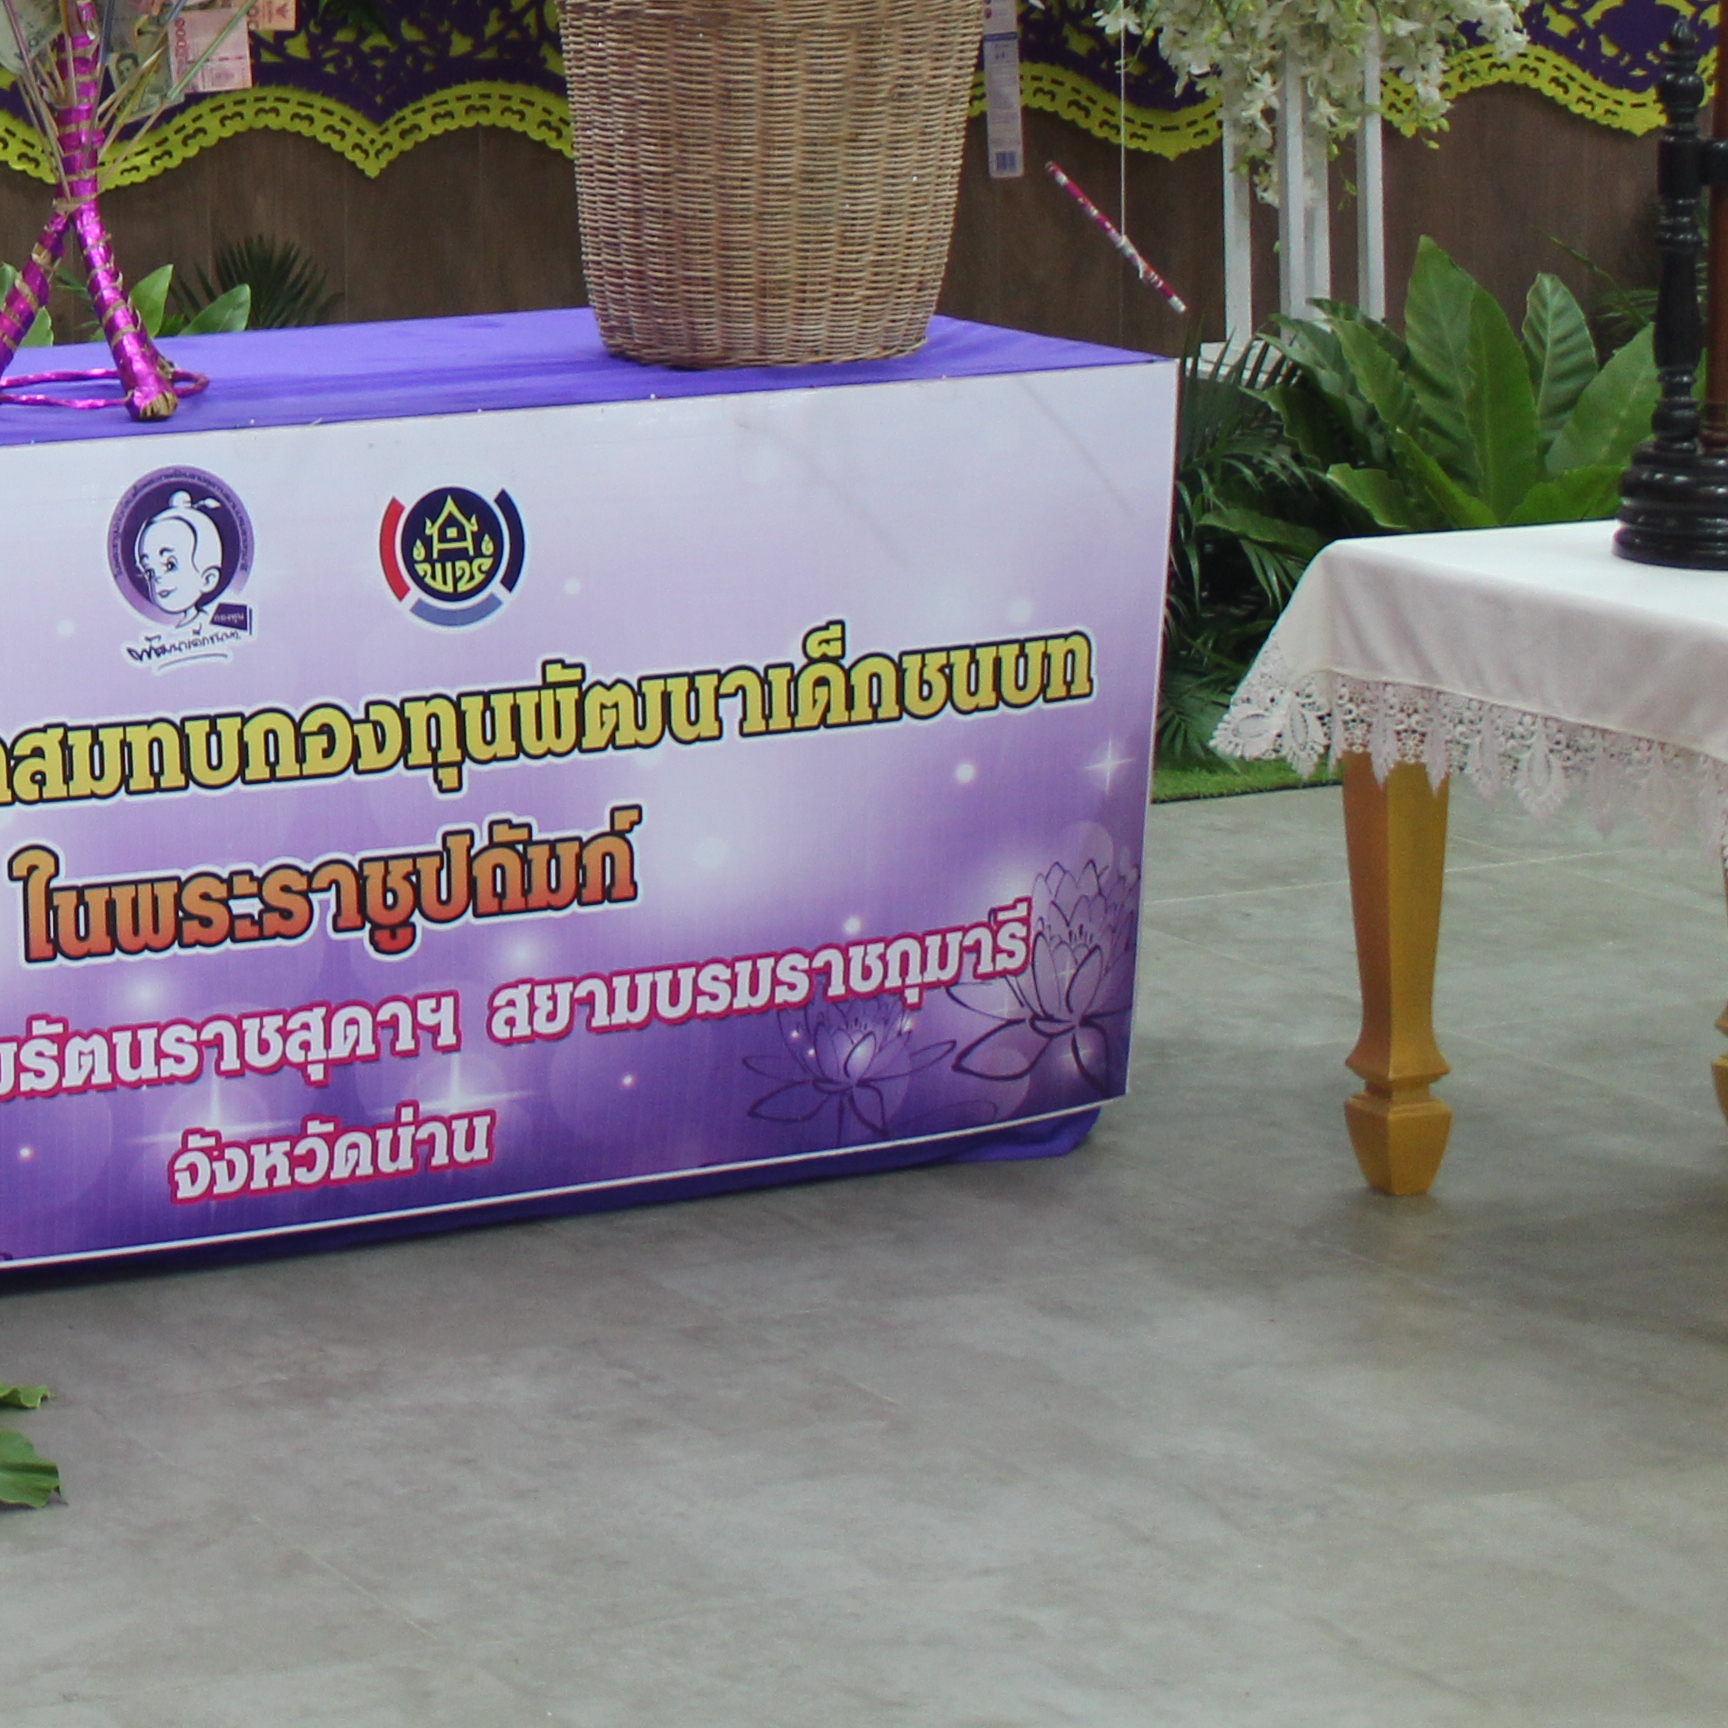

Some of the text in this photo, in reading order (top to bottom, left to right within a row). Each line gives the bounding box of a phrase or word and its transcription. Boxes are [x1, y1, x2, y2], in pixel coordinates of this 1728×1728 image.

[8, 805, 642, 963] ในพระราชูปถัมภ์
[488, 898, 1033, 1043] สยามบรมราชกุมารี
[170, 1102, 495, 1205] จังหวัดน่าน
